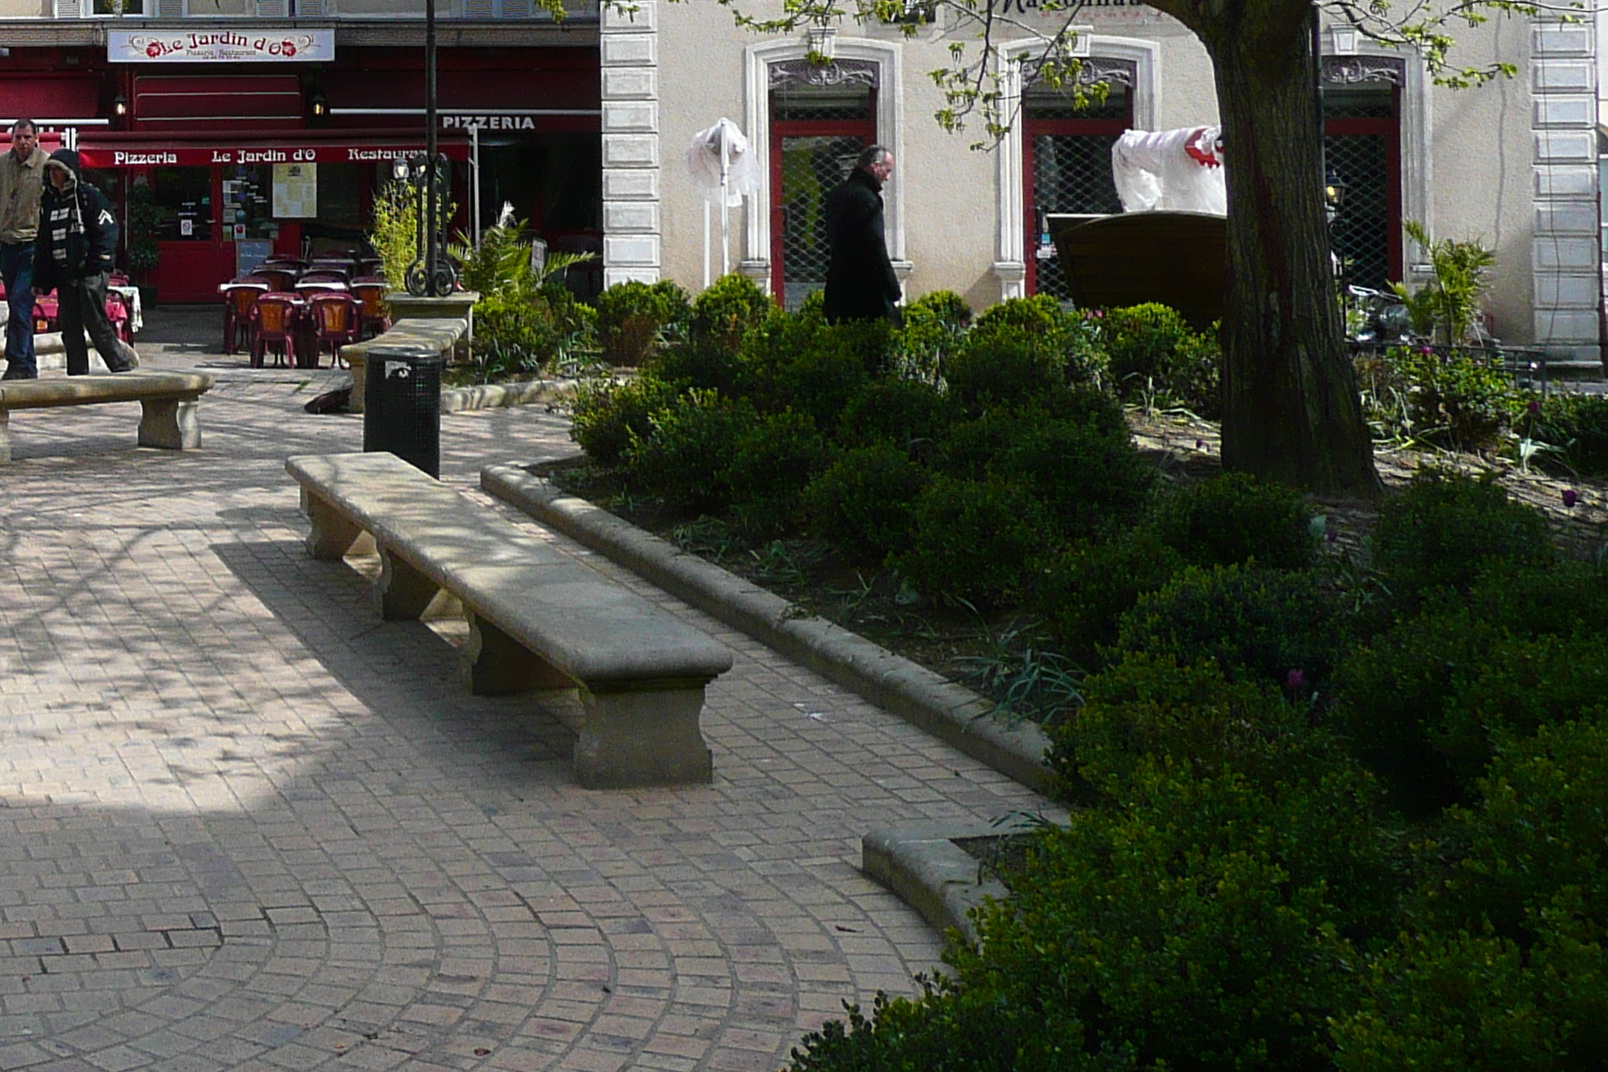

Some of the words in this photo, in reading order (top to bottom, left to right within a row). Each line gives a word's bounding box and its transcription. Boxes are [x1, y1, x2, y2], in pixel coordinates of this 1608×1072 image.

[161, 38, 183, 55] Le
[188, 31, 248, 49] Jardin
[443, 116, 536, 130] PIZZERIA
[113, 151, 178, 165] Pizzeria
[211, 150, 231, 163] Le
[237, 149, 286, 164] Jardin
[347, 148, 428, 160] Restauran
